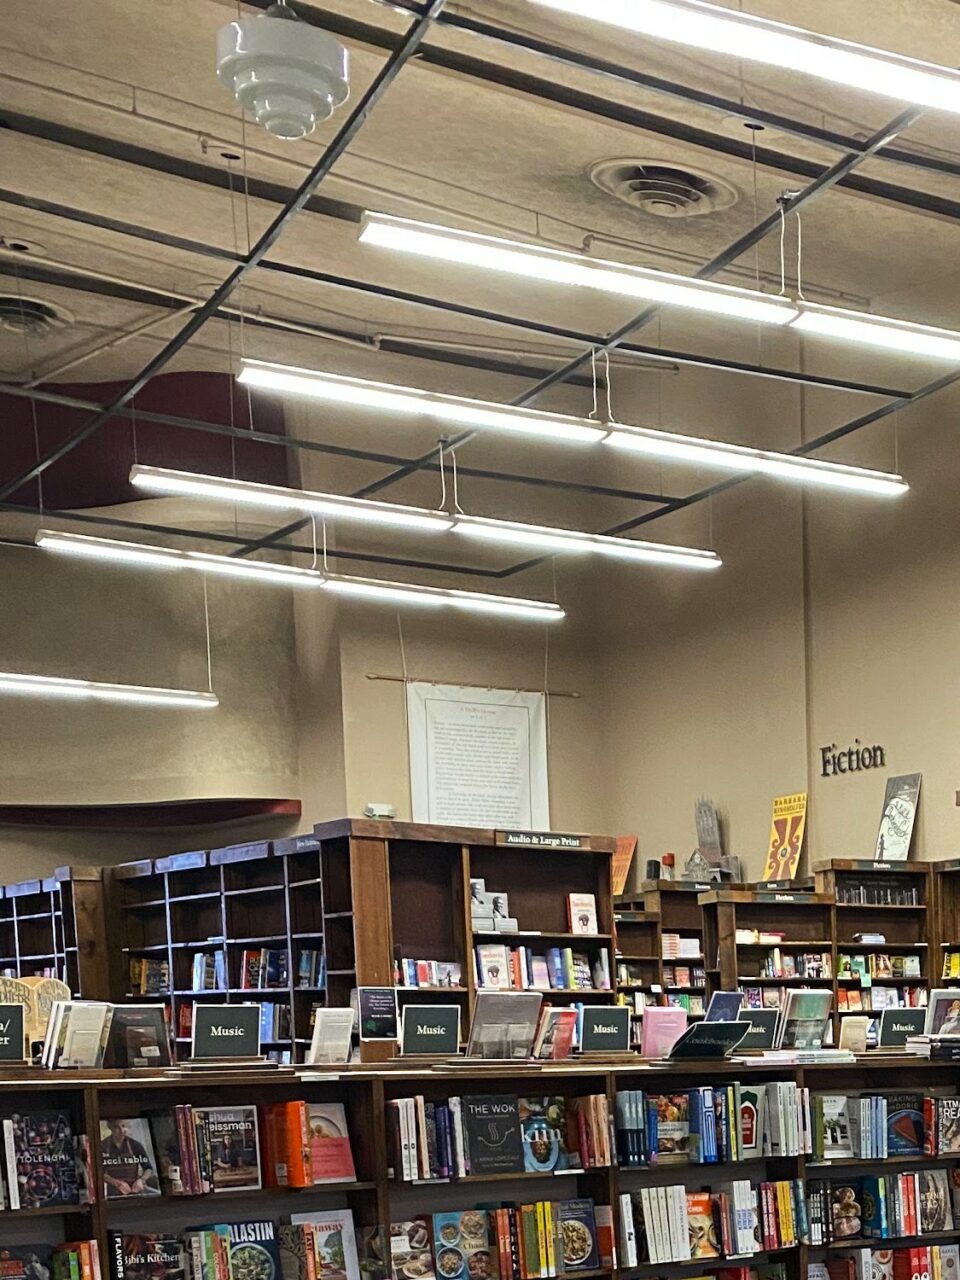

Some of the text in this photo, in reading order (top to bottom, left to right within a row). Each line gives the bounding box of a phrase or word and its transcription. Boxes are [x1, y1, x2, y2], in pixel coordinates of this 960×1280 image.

[820, 738, 886, 777] Fiction
[508, 834, 580, 847] Audio & Large Print
[210, 1025, 244, 1036] Music
[417, 1025, 446, 1035] Music
[593, 1024, 618, 1034] Music
[892, 1023, 915, 1033] Music
[468, 1103, 516, 1114] THE WOK
[209, 1111, 235, 1121] shua
[209, 1120, 253, 1132] eissman
[124, 1156, 149, 1165] table
[229, 1222, 275, 1242] ALASTIN
[114, 1237, 125, 1278] FLAVORS
[147, 1252, 182, 1264] Kitchen
